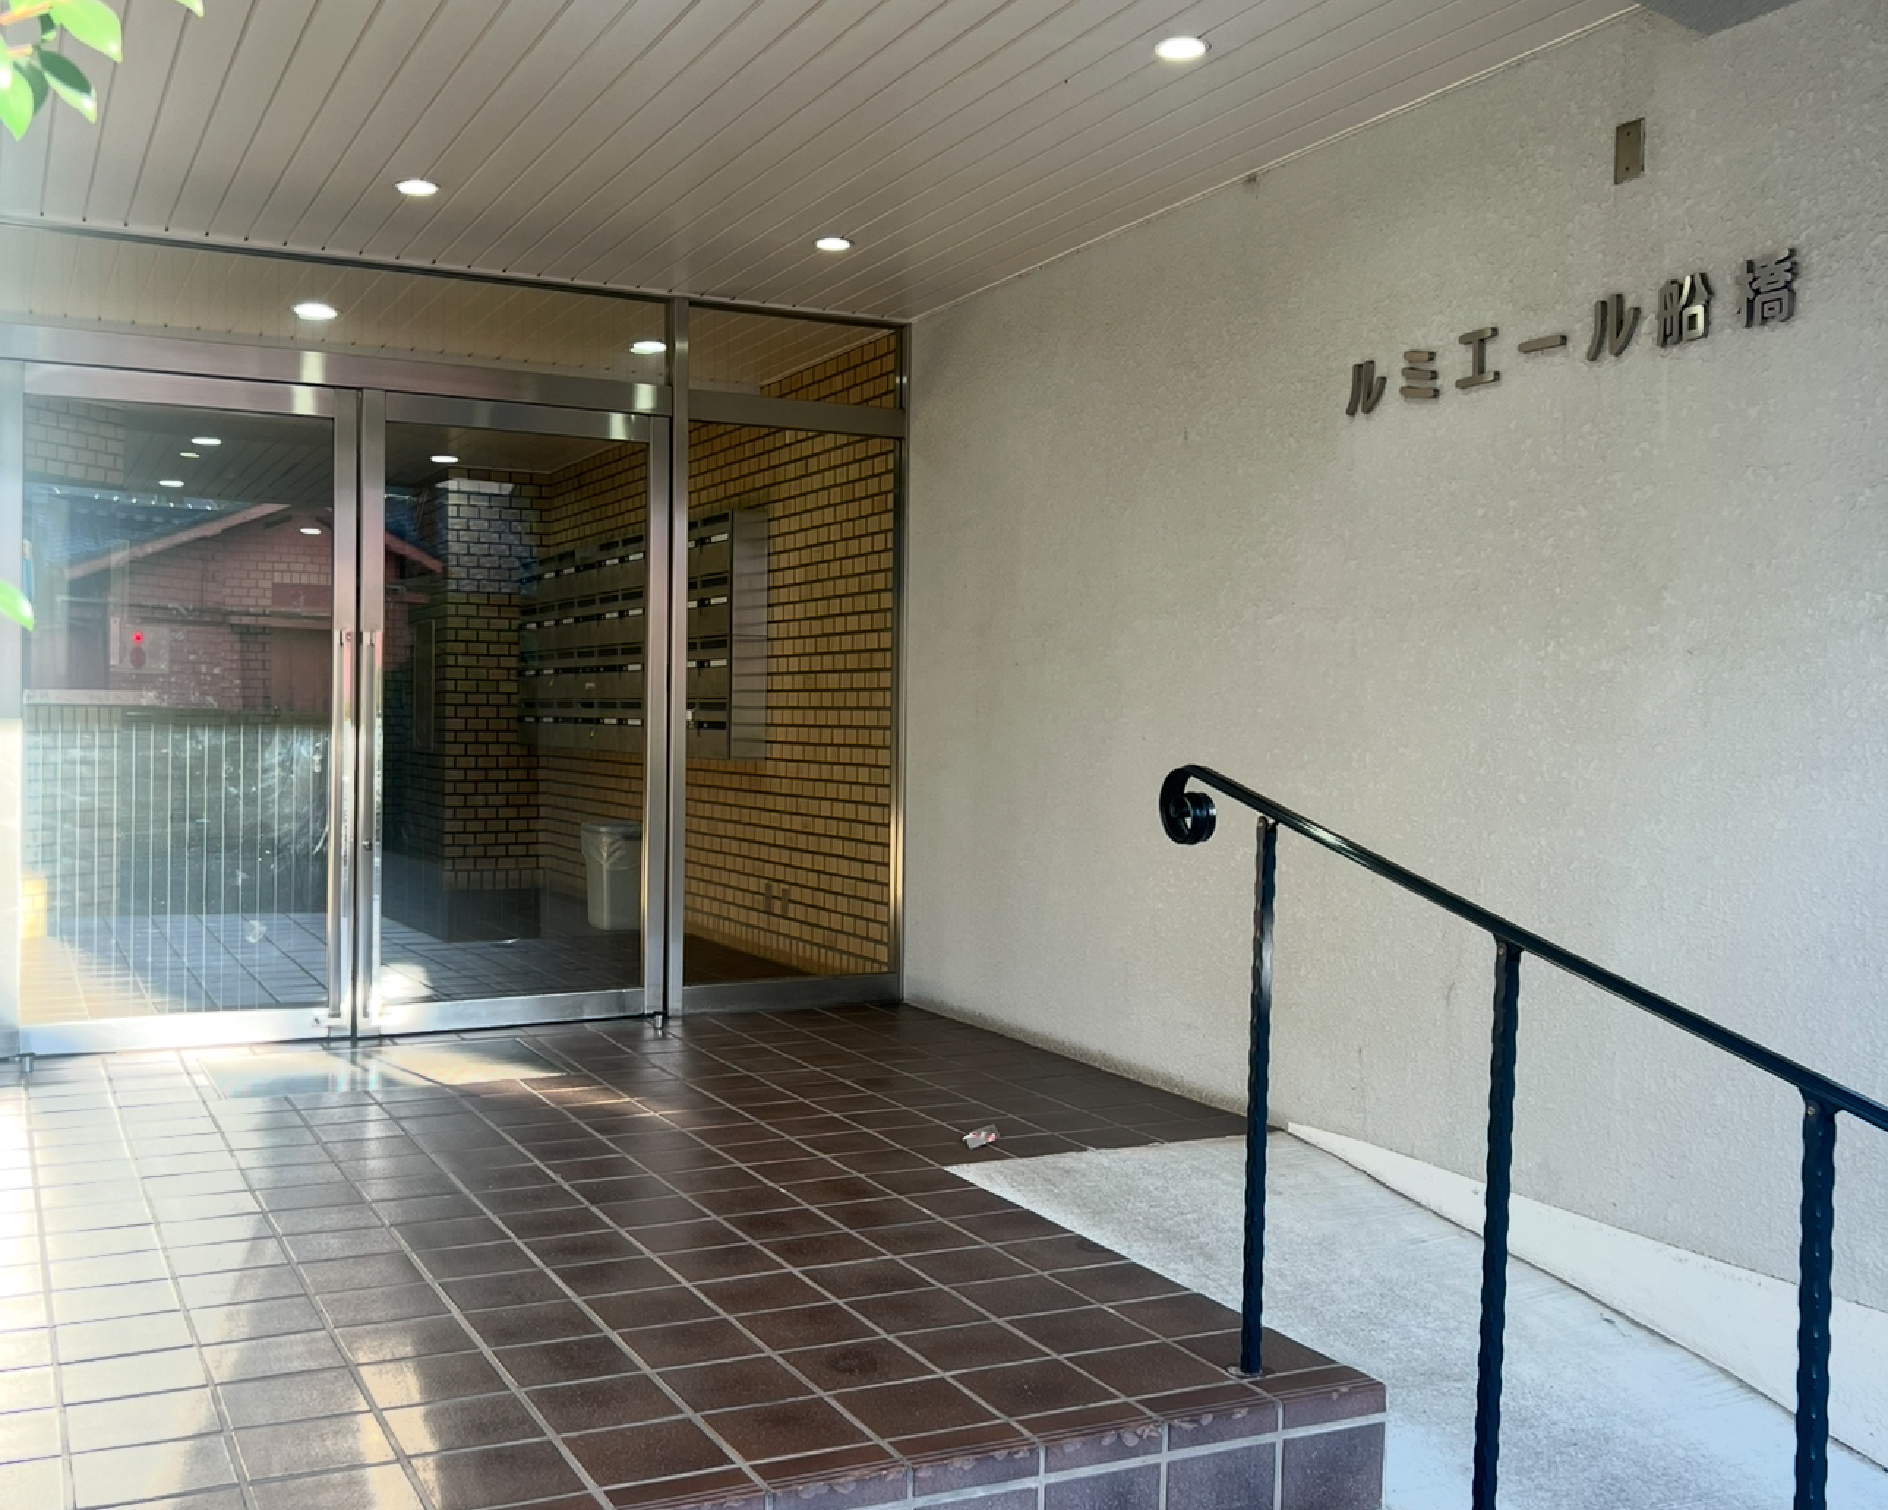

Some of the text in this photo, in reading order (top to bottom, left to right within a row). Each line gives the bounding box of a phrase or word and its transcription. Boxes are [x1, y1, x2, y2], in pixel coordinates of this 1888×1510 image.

[1346, 247, 1798, 416] ルミエール船橋
